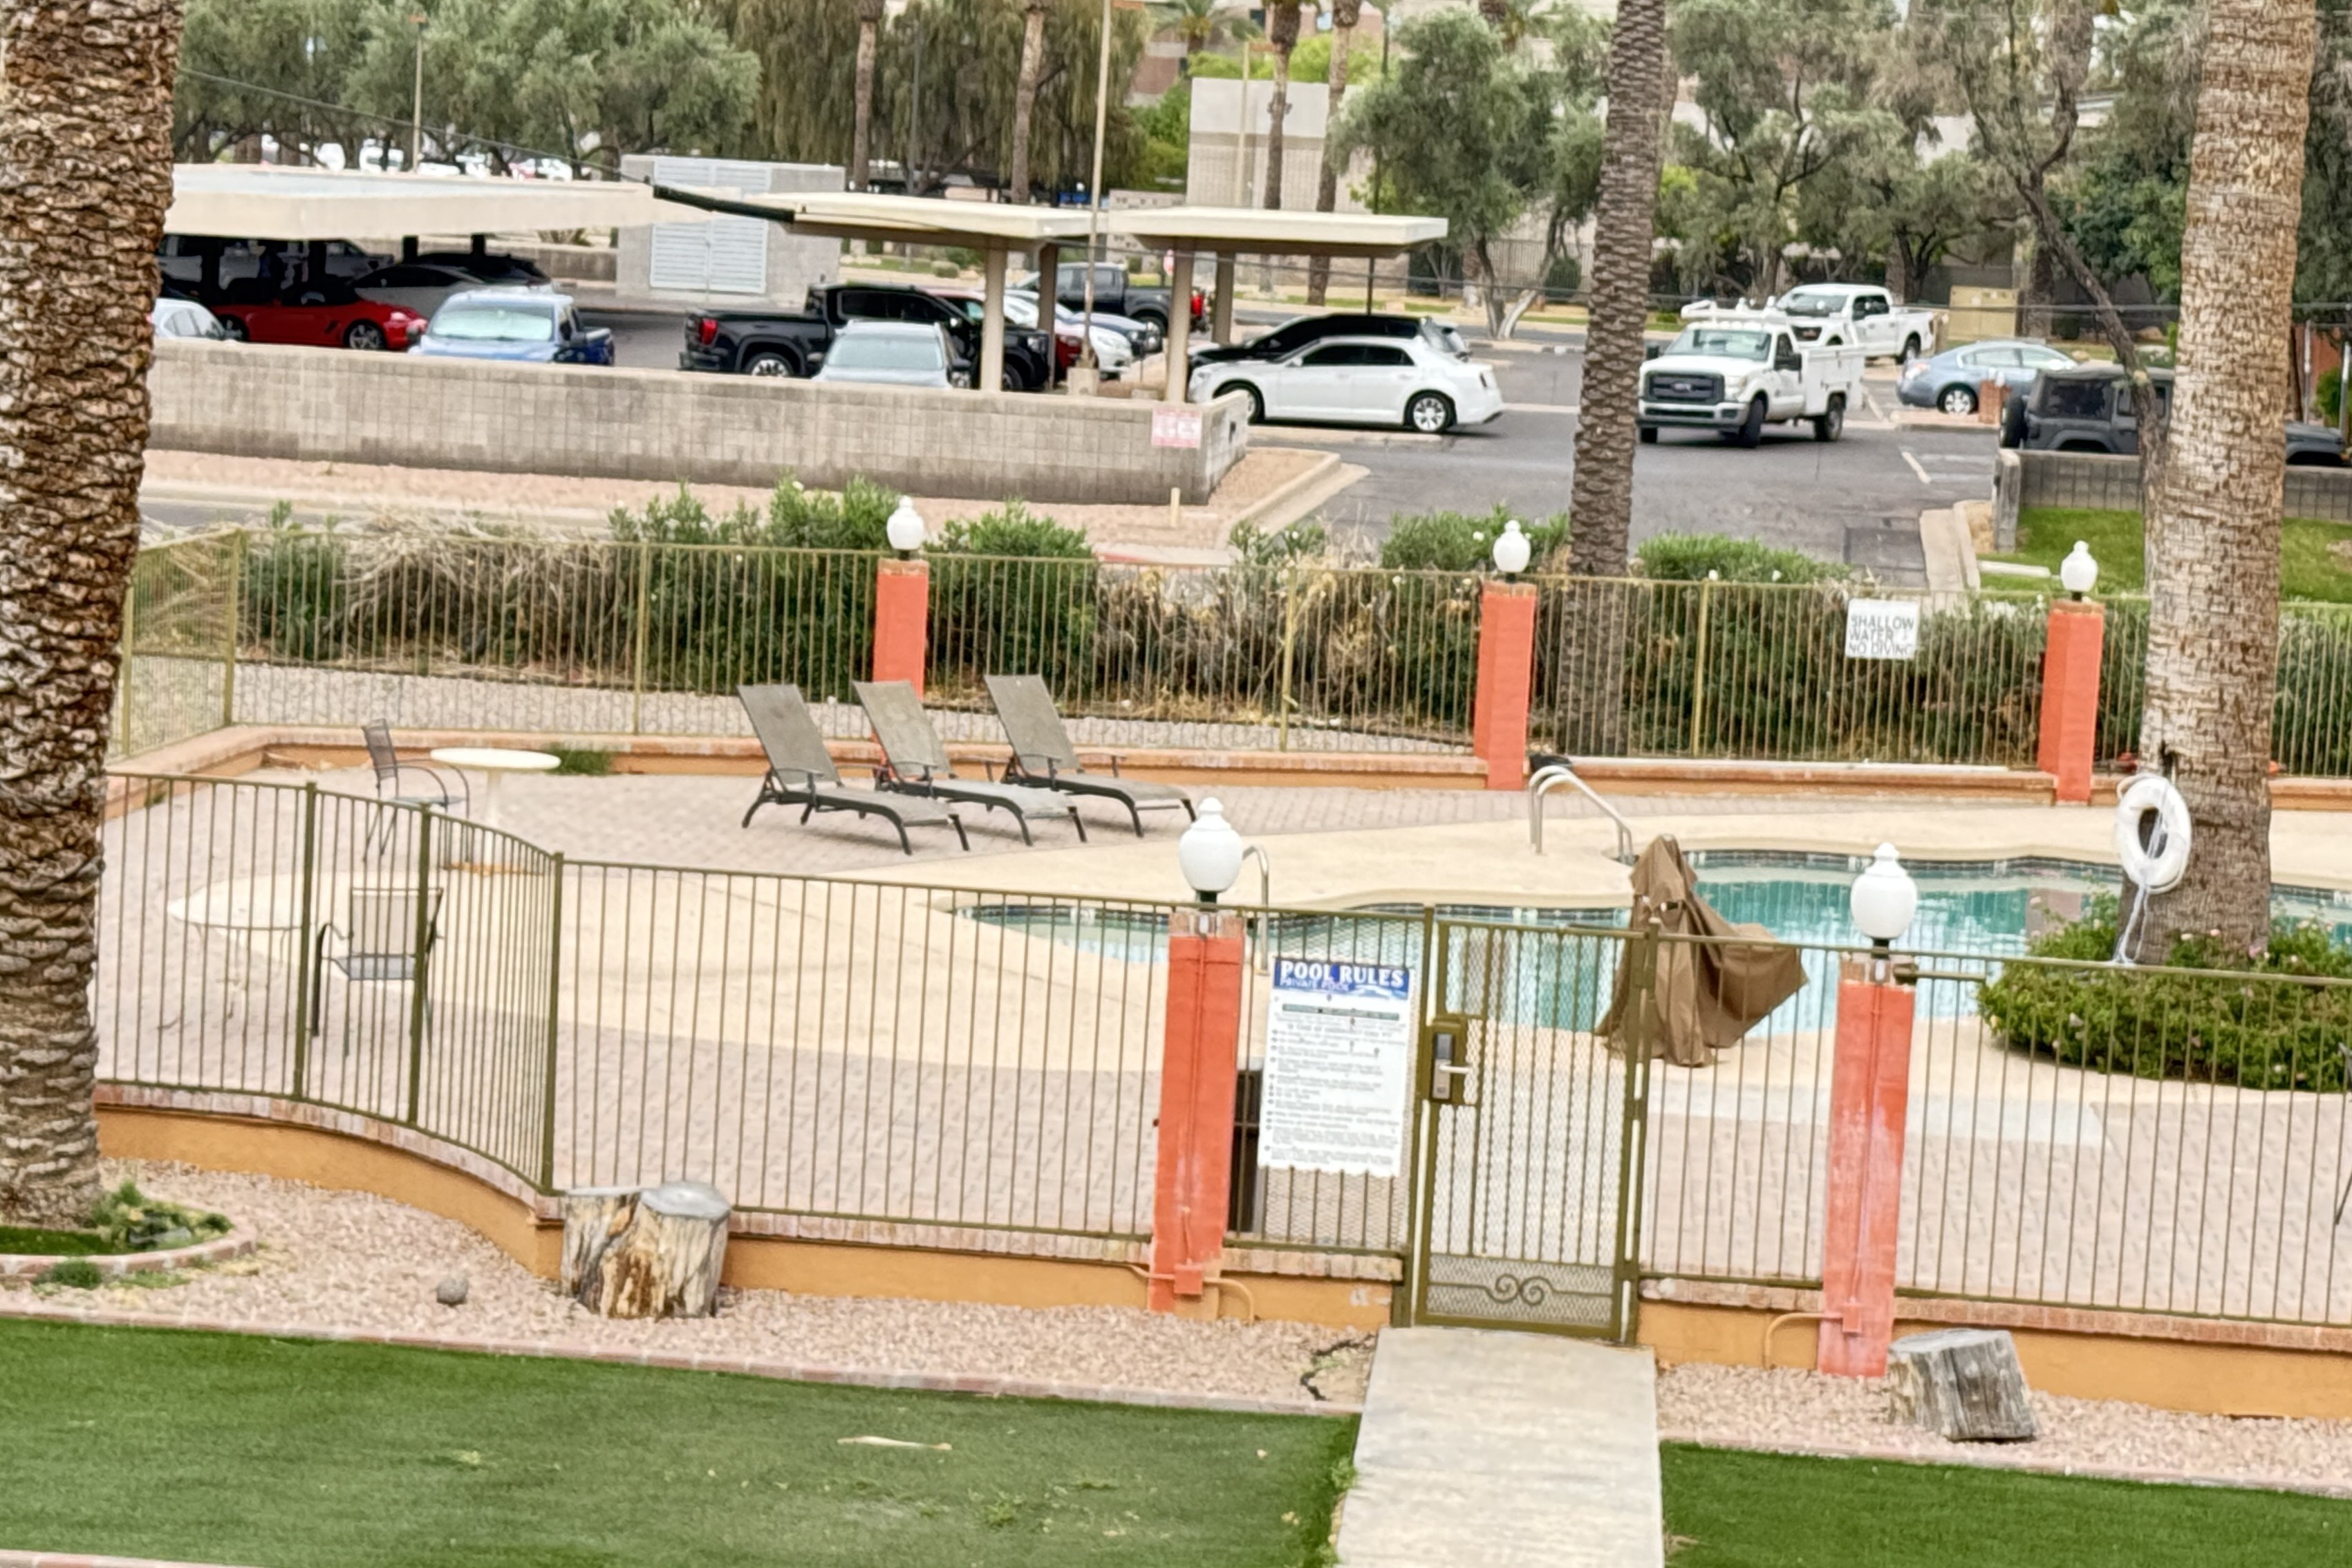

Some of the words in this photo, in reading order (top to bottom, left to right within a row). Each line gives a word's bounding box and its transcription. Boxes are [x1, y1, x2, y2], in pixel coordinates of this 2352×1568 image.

[1851, 615, 1914, 630] SHALLOW
[1849, 626, 1894, 642] WATER
[1849, 642, 1867, 655] NO
[1280, 960, 1334, 980] POOL
[1338, 965, 1405, 987] RULES
